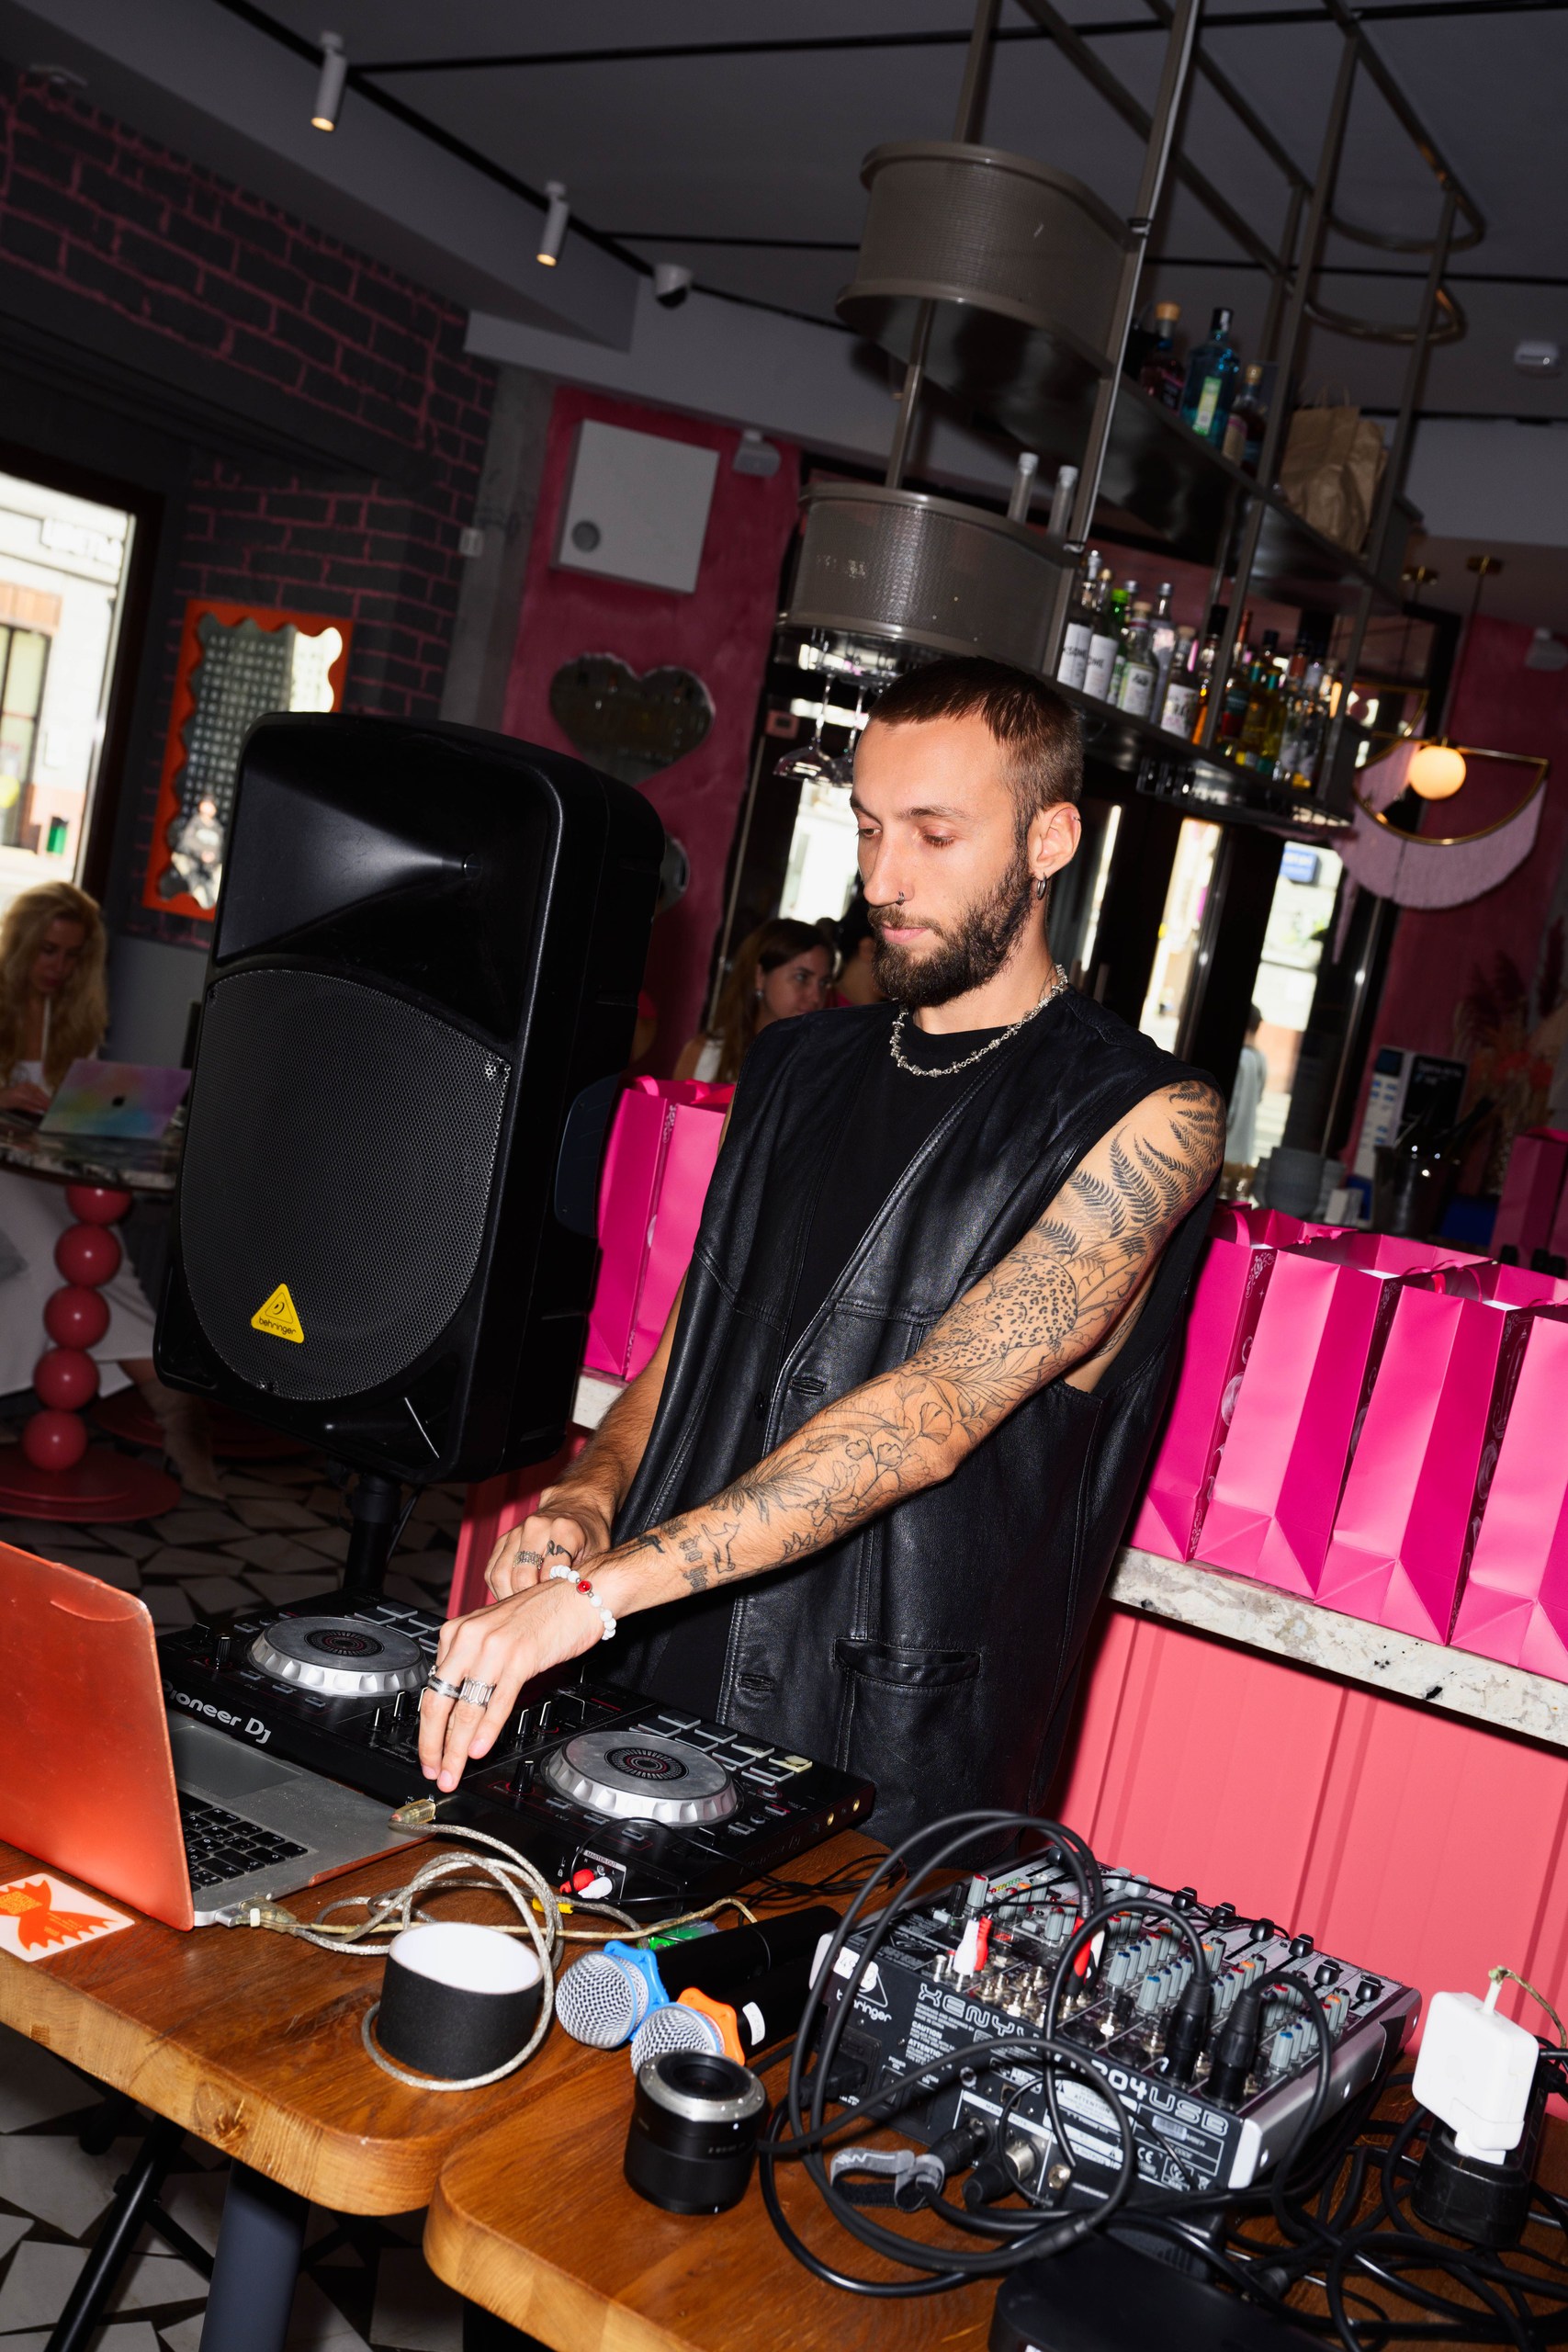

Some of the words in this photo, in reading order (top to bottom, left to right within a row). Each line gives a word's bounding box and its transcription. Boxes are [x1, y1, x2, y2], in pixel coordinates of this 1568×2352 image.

[259, 1317, 296, 1335] behringer
[587, 1851, 605, 1861] MASTER
[912, 2020, 942, 2039] CAUTION
[908, 2038, 943, 2059] ATTENTIO
[888, 2055, 906, 2067] POWER
